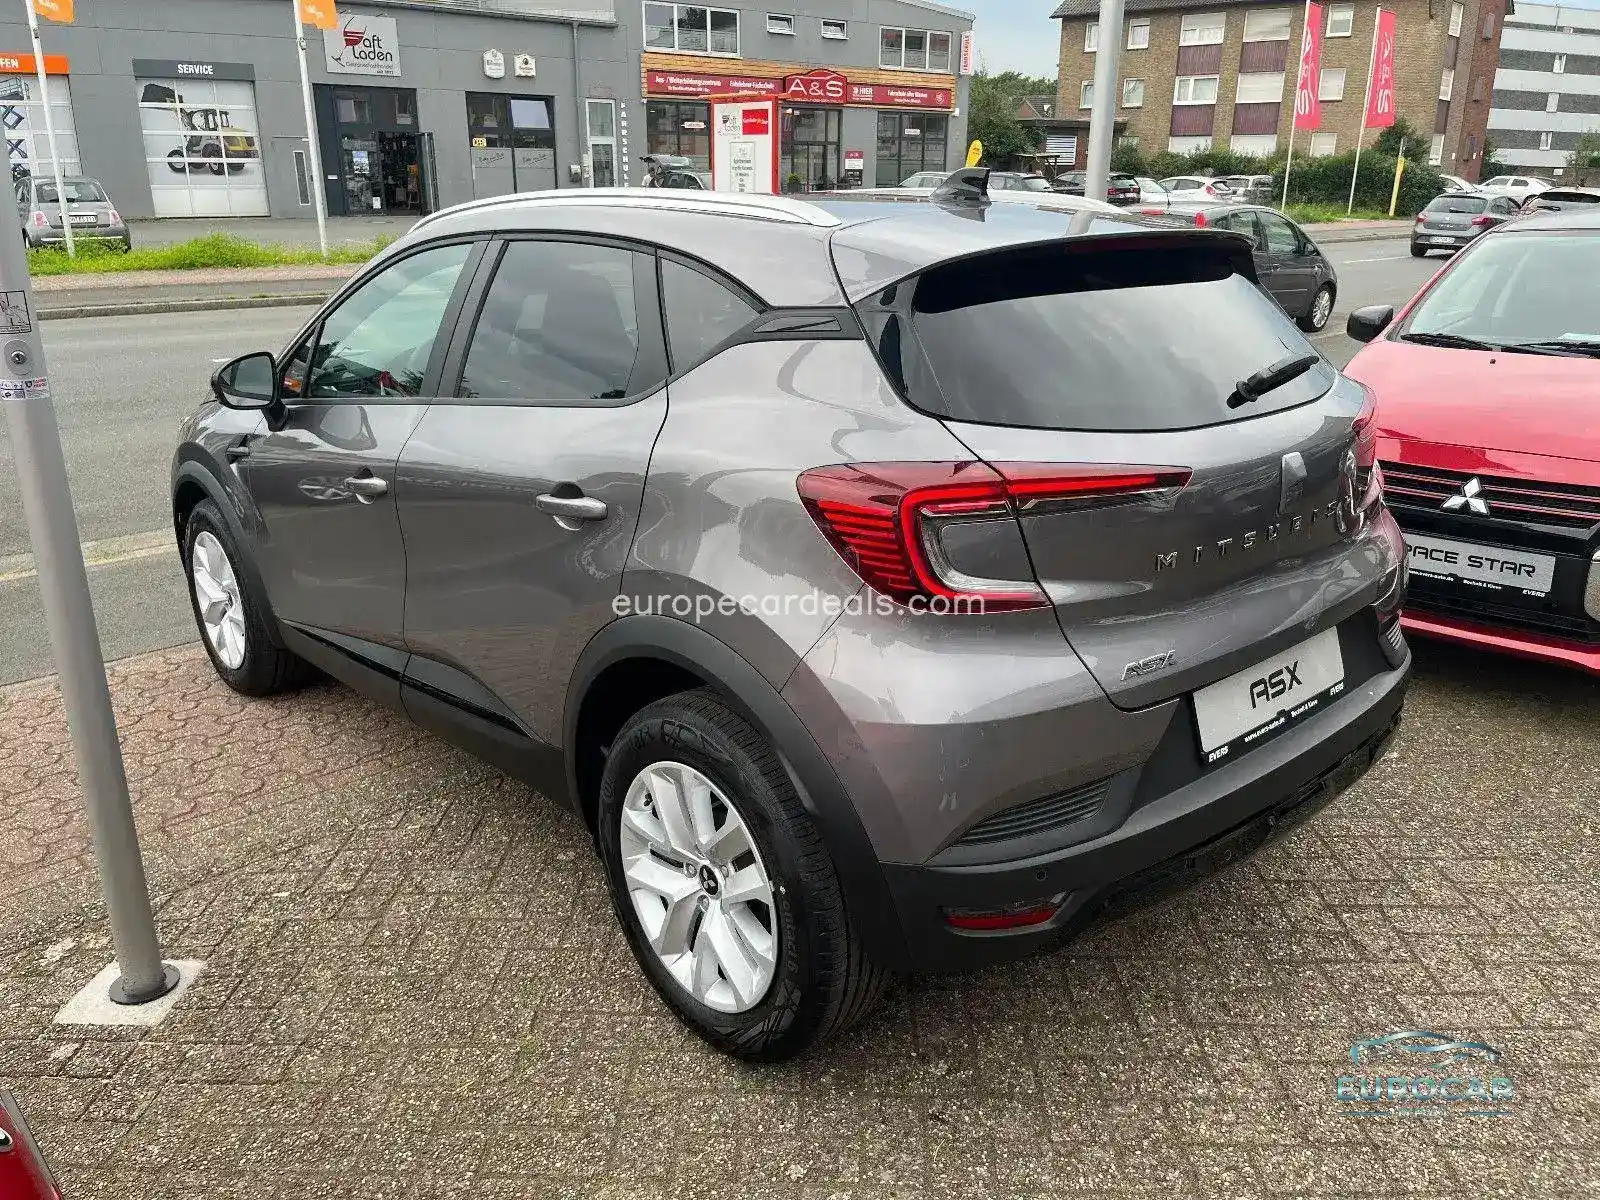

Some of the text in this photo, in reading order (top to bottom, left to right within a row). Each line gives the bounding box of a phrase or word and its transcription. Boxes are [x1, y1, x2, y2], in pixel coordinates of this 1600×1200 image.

[178, 64, 213, 75] SERVICE
[1467, 555, 1536, 578] STAR
[1522, 588, 1546, 598] EVERS
[1121, 650, 1176, 681] ASX
[1250, 660, 1303, 709] ASX
[1208, 745, 1229, 763] EVERS
